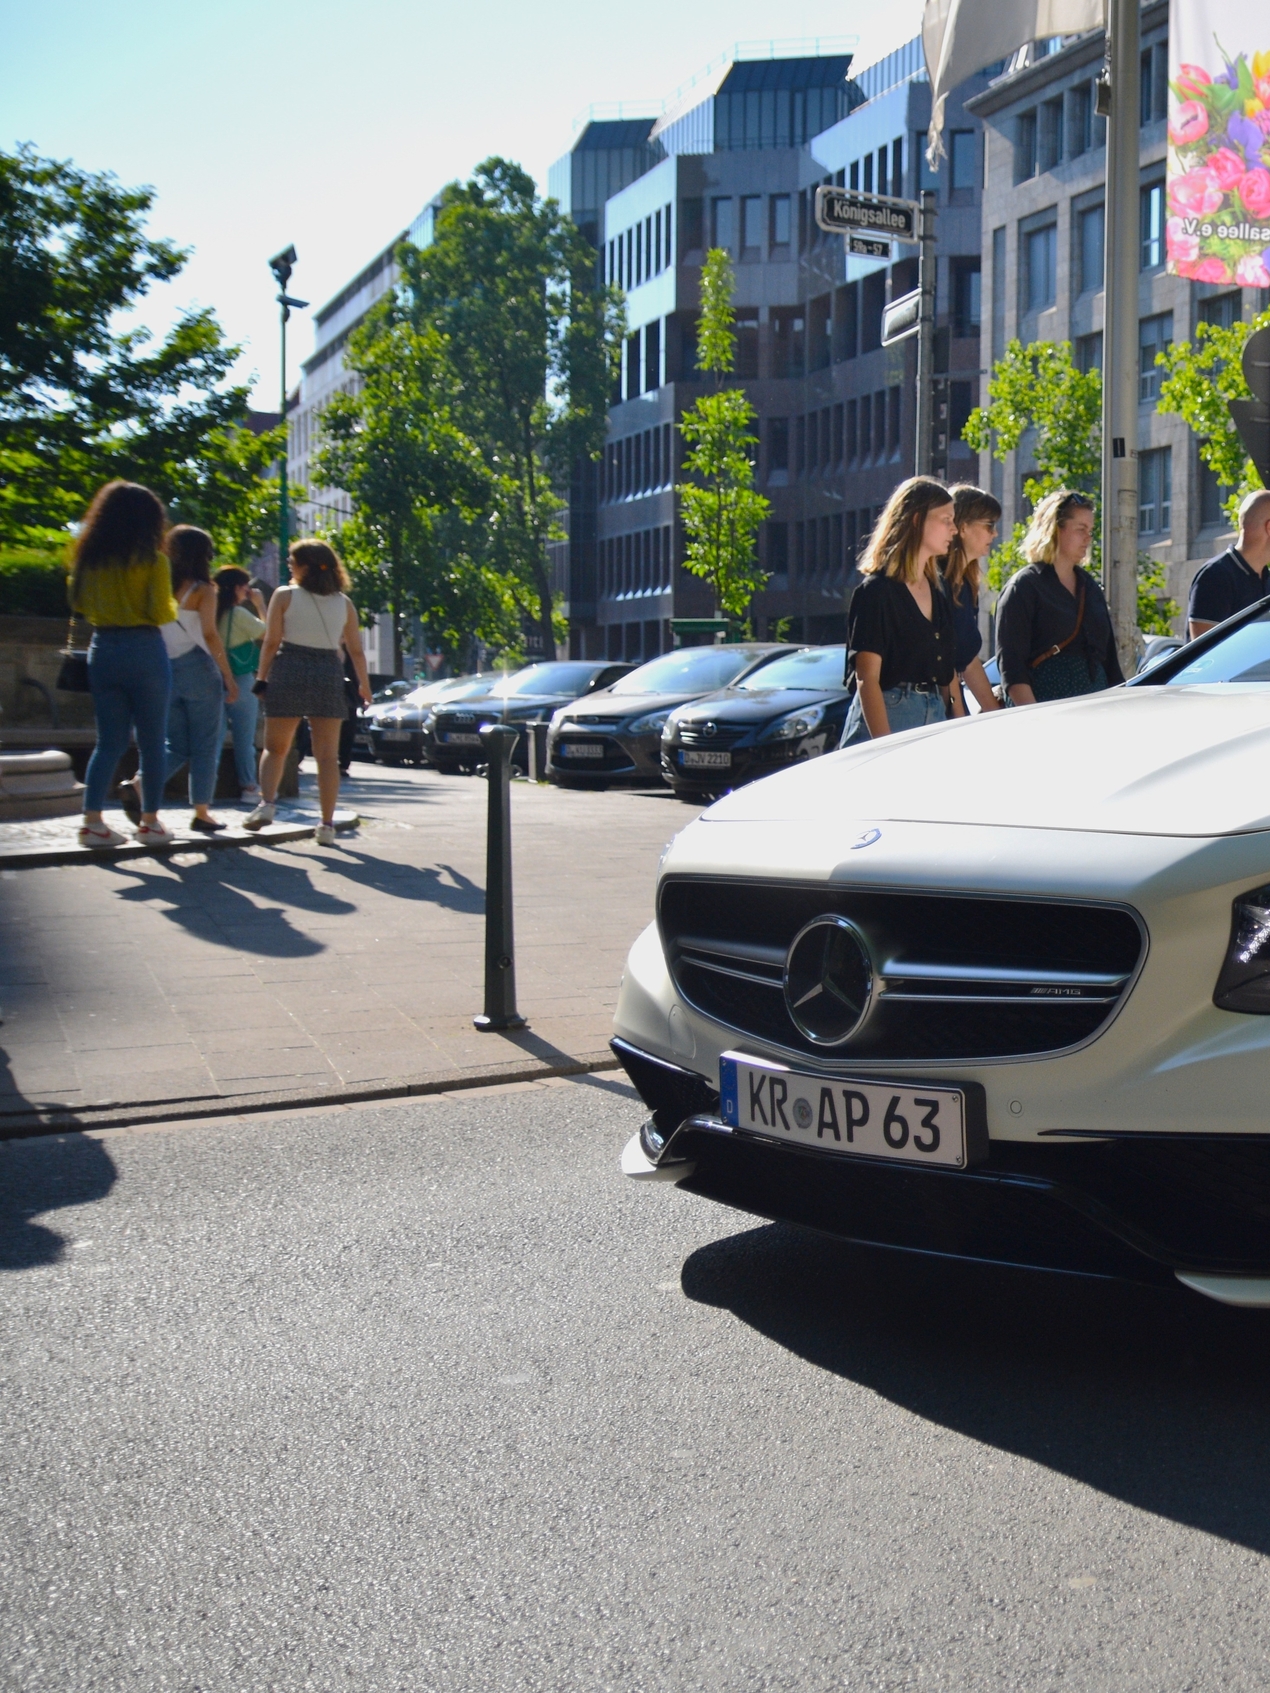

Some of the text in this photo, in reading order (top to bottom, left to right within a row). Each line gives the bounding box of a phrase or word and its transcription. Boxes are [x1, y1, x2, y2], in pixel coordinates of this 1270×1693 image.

[833, 199, 906, 228] Königsallee
[1046, 987, 1081, 995] AMG
[749, 1072, 940, 1153] KR AP 63
